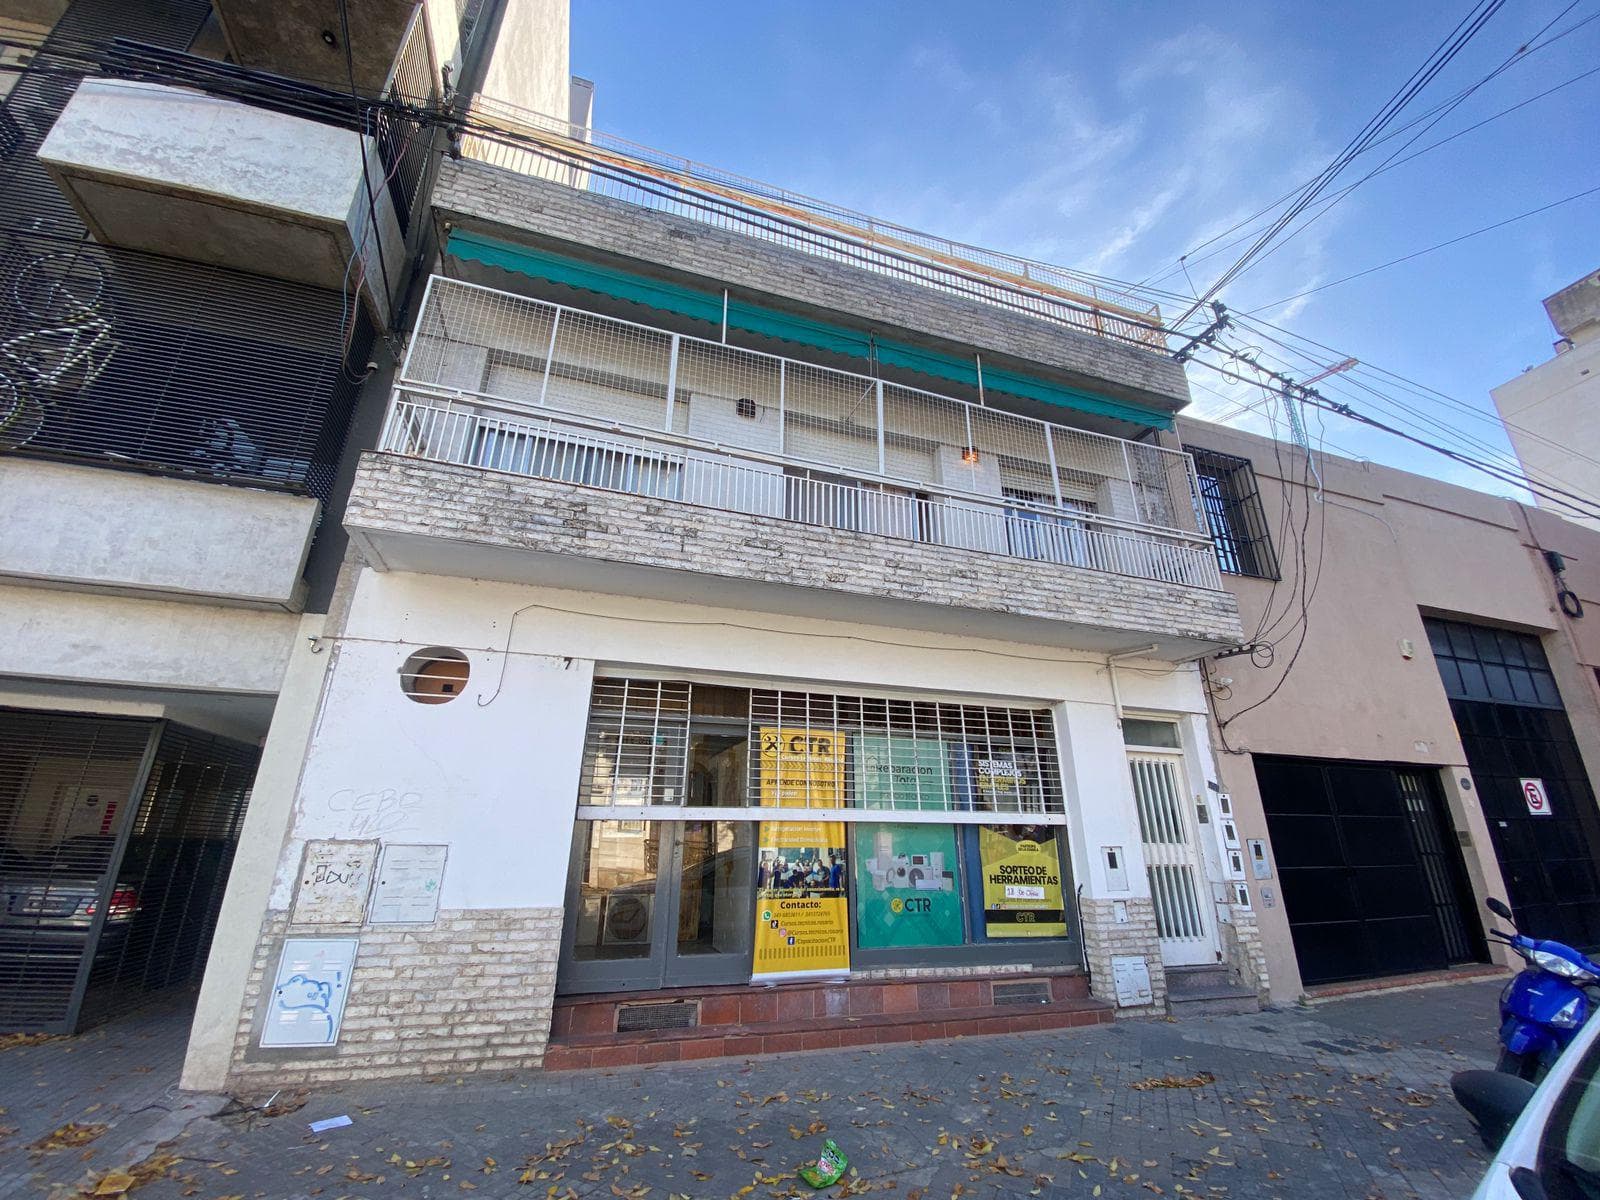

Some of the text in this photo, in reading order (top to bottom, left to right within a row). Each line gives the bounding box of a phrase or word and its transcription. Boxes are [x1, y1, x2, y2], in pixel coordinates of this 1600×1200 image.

[790, 736, 831, 755] CTR
[999, 865, 1048, 876] SORTEO DE
[989, 874, 1059, 886] HERRAMIENTAS
[780, 900, 822, 910] Contacto:
[904, 897, 932, 913] CTR
[1016, 911, 1036, 923] CTR
